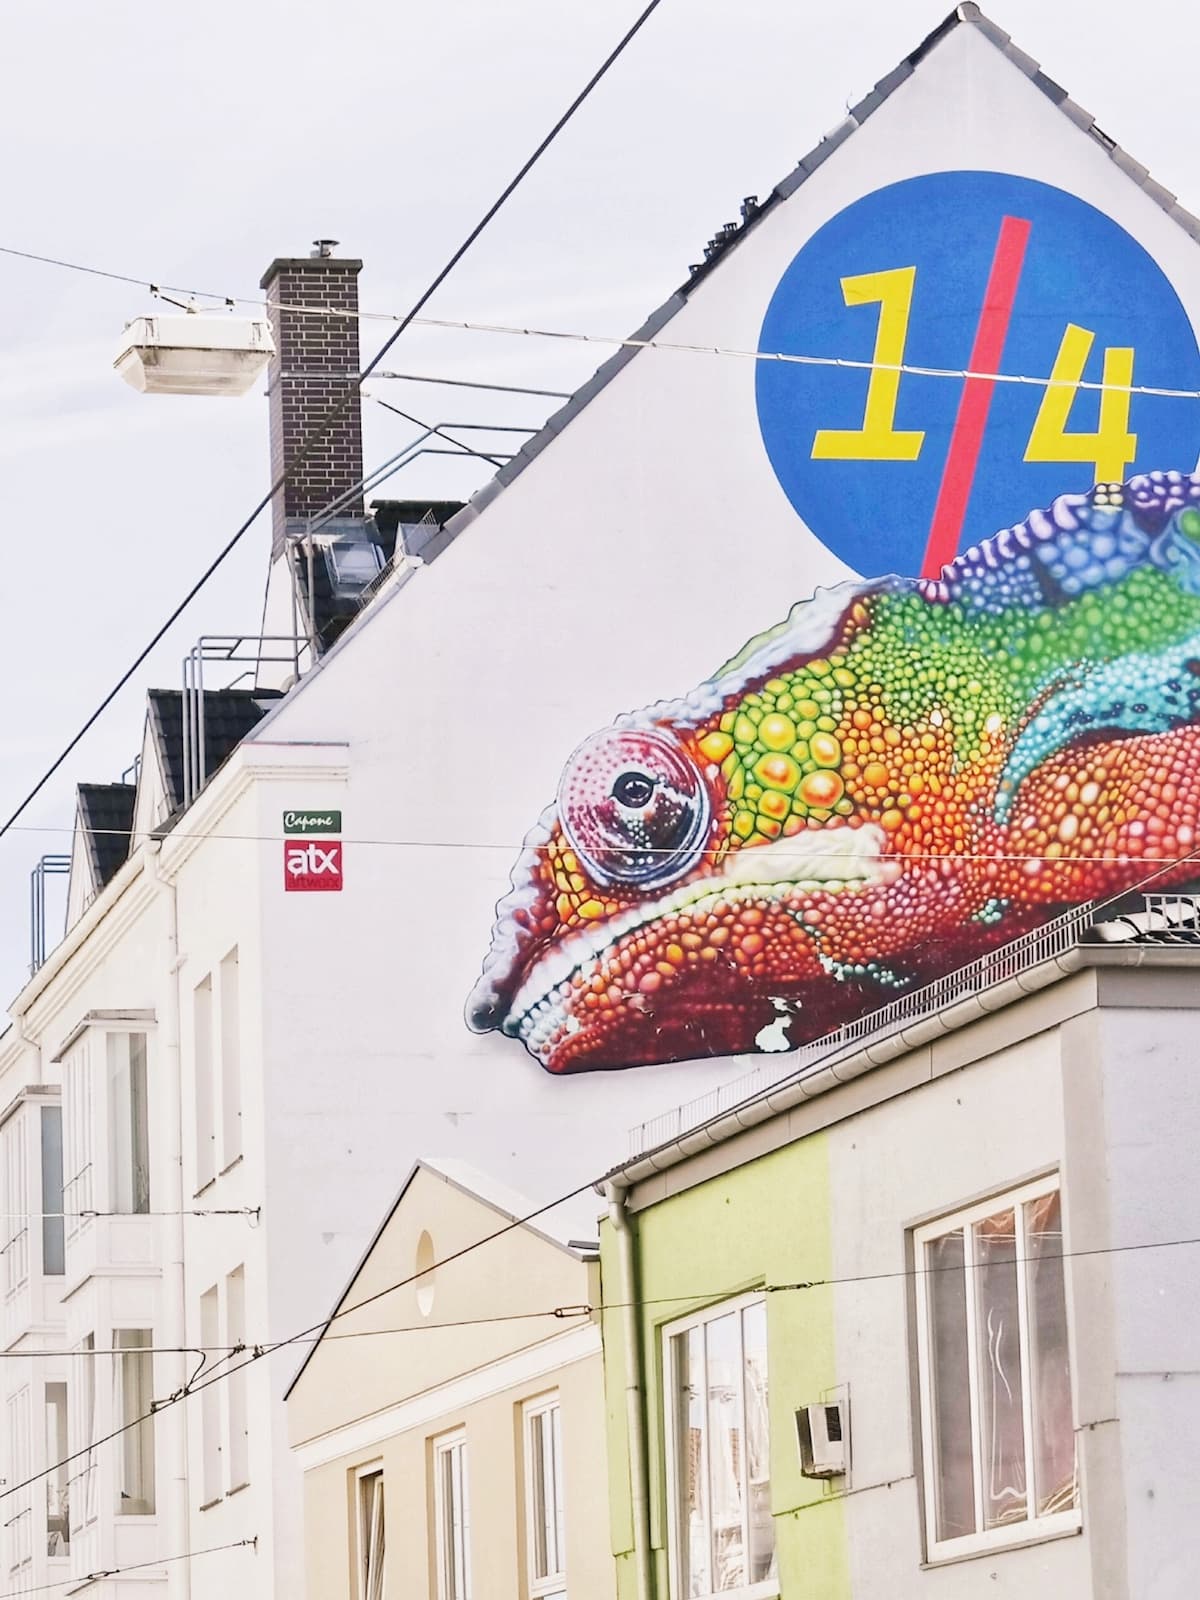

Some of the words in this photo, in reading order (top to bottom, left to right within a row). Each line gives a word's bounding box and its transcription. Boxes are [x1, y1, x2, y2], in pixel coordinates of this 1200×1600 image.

[810, 215, 1137, 579] 1/4
[285, 812, 333, 831] Capone
[287, 843, 340, 879] atx
